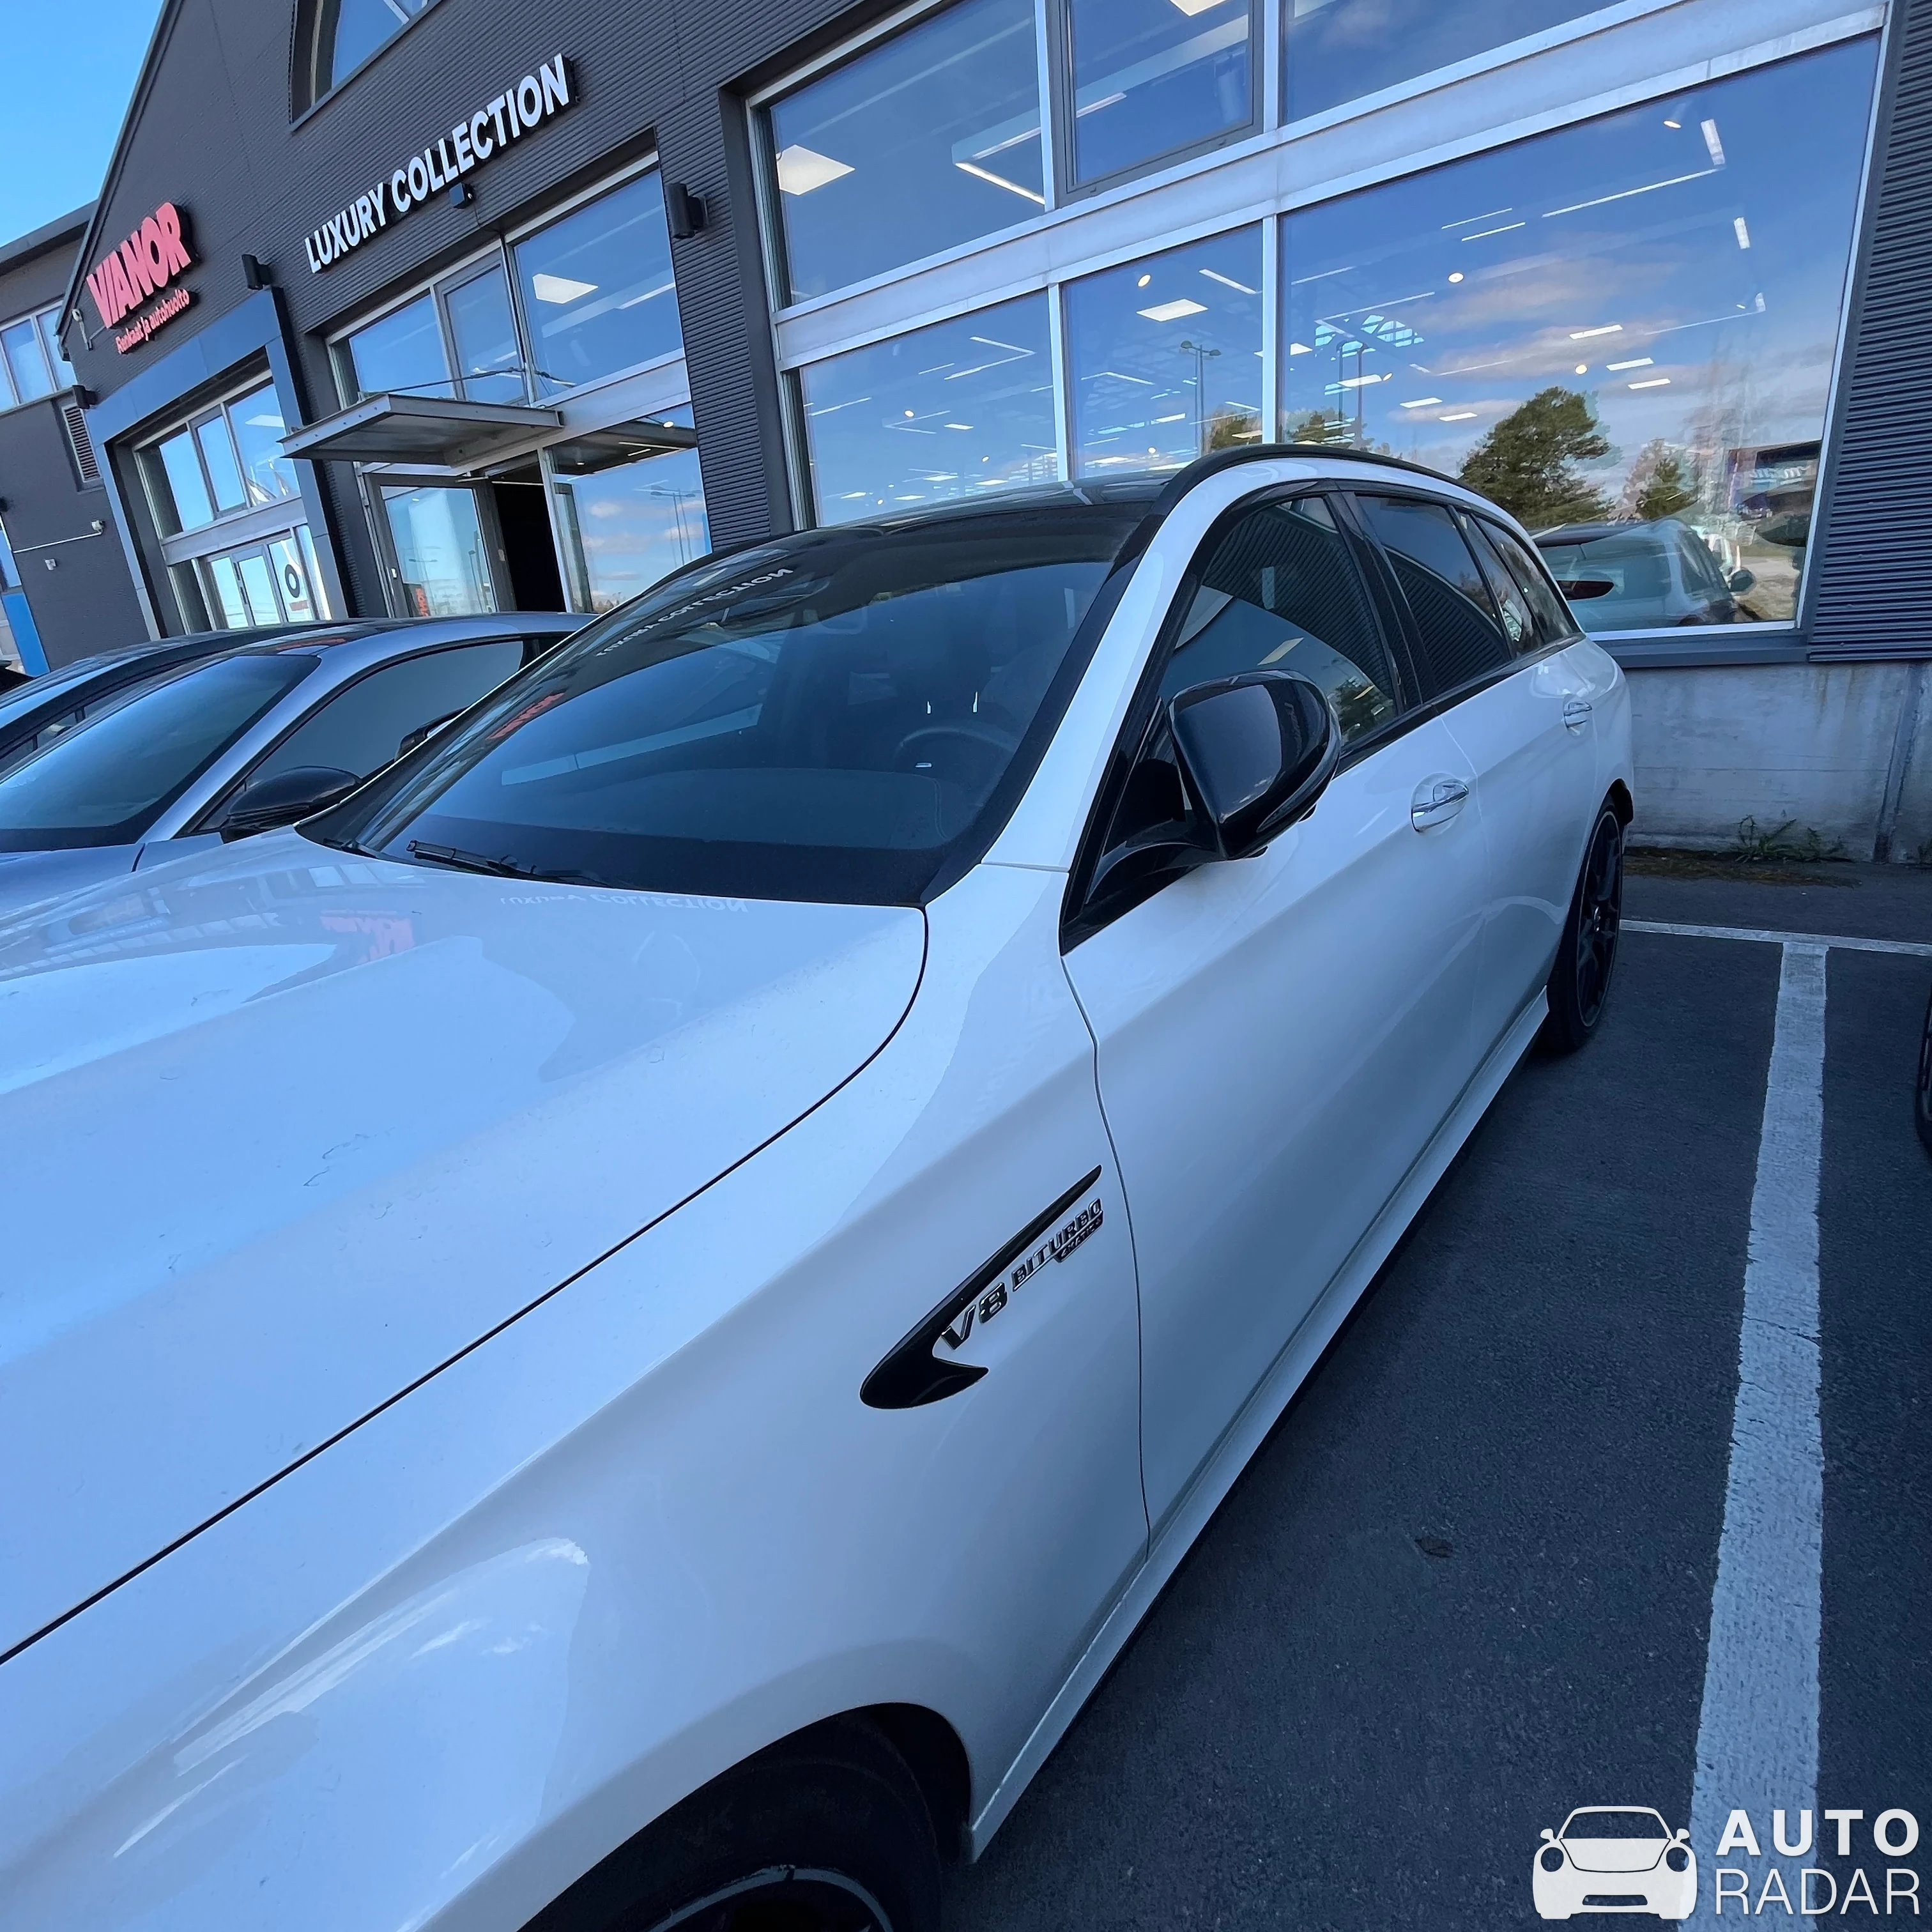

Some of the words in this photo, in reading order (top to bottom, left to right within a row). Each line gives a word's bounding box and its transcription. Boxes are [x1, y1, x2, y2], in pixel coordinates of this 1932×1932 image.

[304, 182, 387, 273] LUXURY
[391, 52, 569, 213] COLLECTION
[86, 202, 192, 329] VIANOR
[941, 1282, 1008, 1351] V8
[1011, 1197, 1102, 1291] BITURBO
